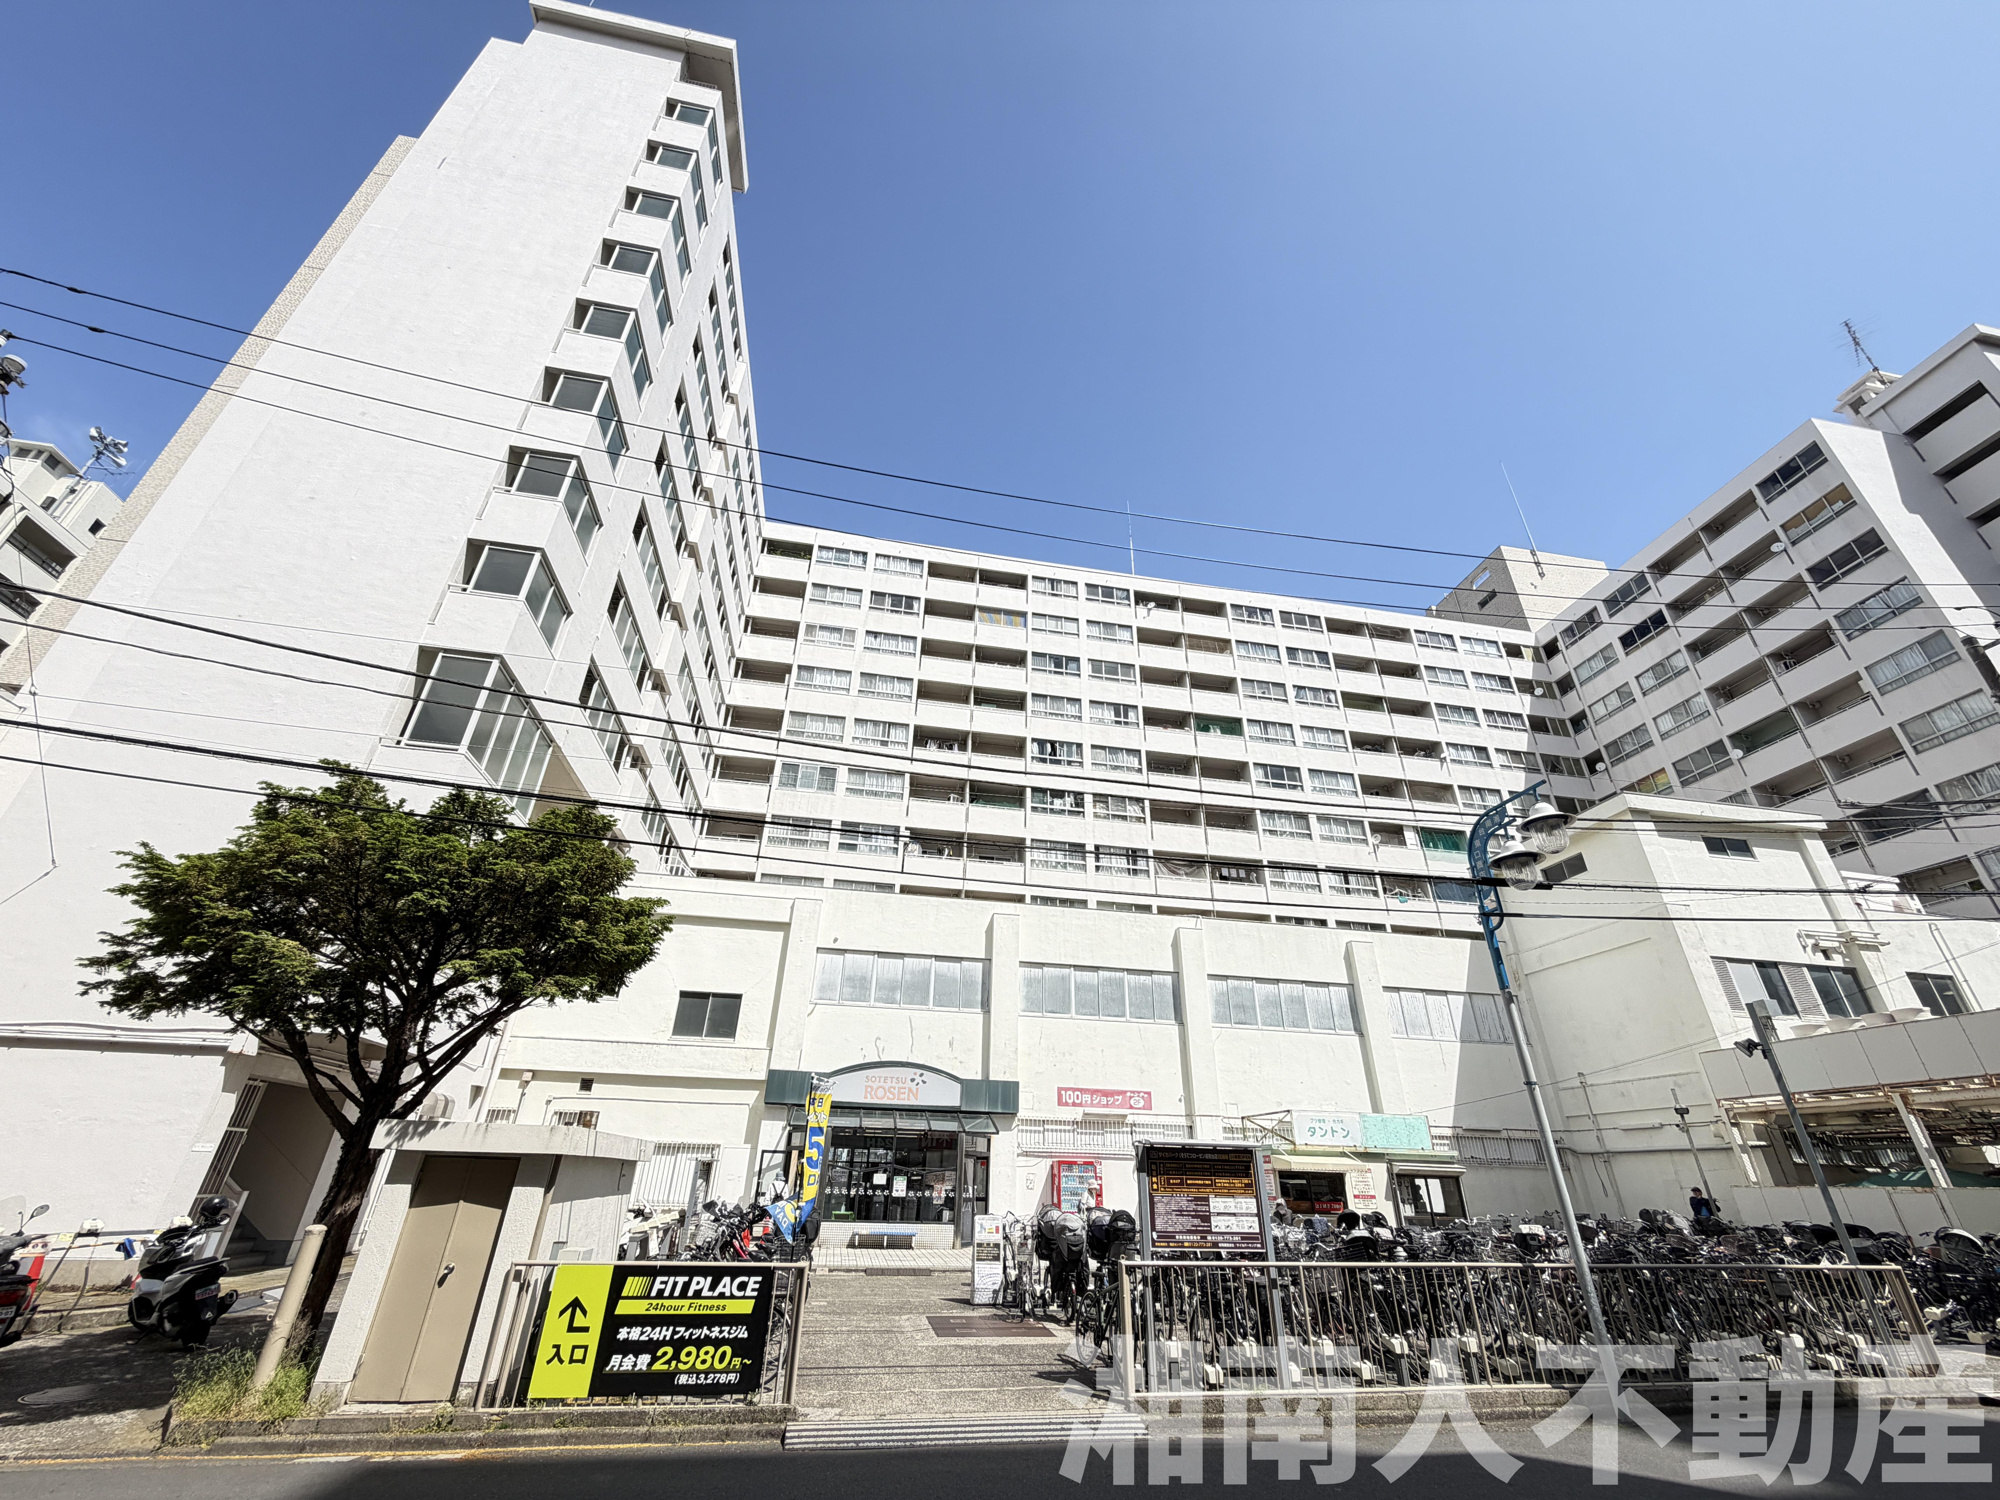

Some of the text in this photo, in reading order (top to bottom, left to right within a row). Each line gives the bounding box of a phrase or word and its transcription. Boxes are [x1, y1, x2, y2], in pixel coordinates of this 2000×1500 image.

[865, 1075, 907, 1085] SOTETSU
[864, 1085, 919, 1101] ROSEN
[1060, 1091, 1122, 1106] 100円ショップ
[1307, 1126, 1350, 1138] タントン
[650, 1277, 762, 1297] FIT PLACE
[645, 1302, 727, 1312] 24hour Fitness
[546, 1344, 588, 1366] 入口
